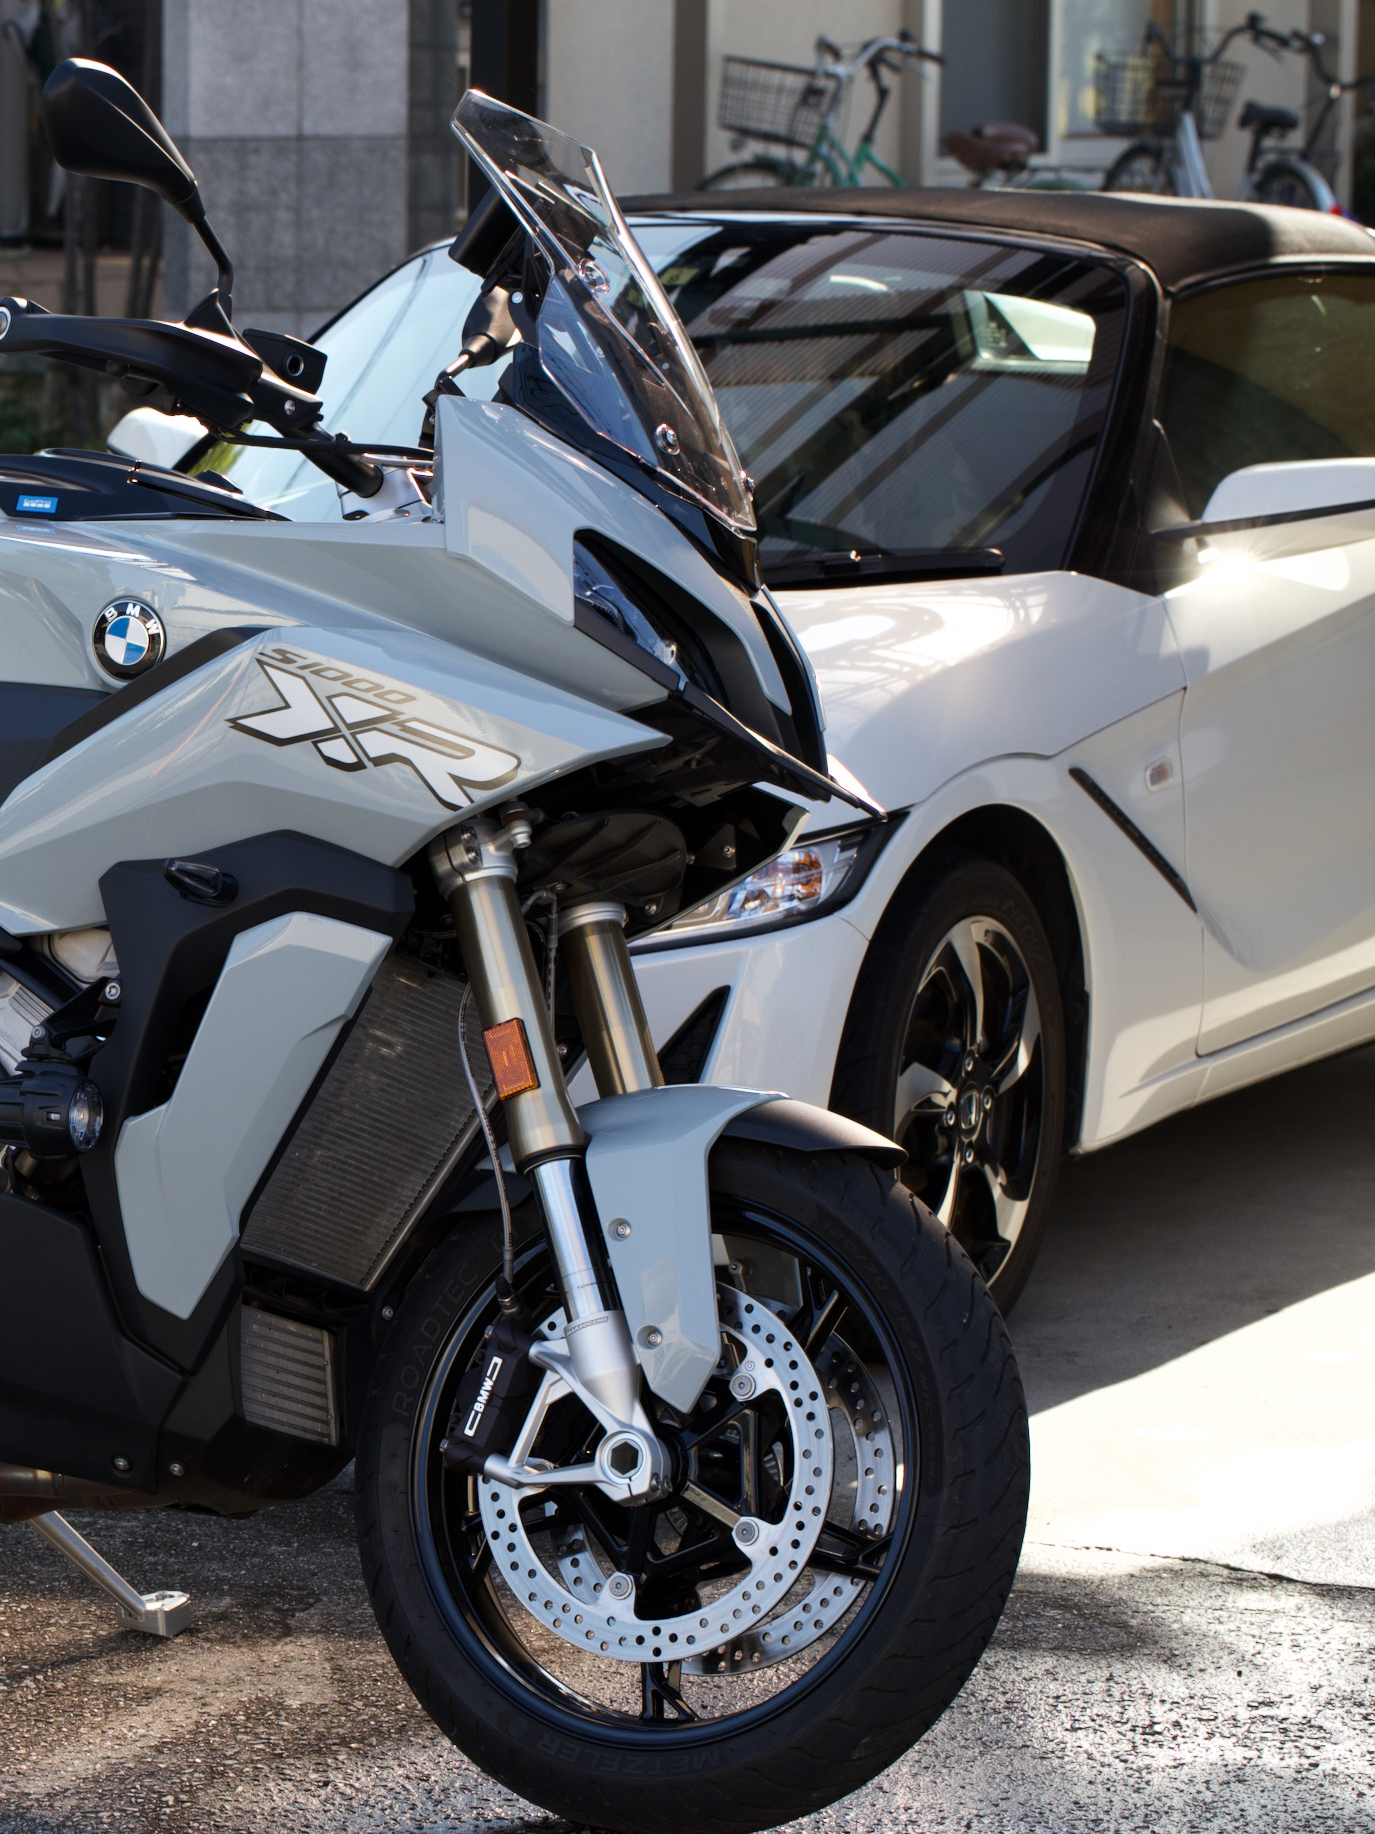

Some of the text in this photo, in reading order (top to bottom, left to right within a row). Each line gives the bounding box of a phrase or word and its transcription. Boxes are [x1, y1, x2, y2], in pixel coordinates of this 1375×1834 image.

[104, 602, 161, 635] BMW
[257, 648, 417, 705] S1000
[224, 657, 522, 812] XR
[821, 1220, 889, 1290] 120/70
[391, 1262, 480, 1417] ROADTEC
[473, 1373, 494, 1413] BMW
[534, 1732, 721, 1776] METZELER
